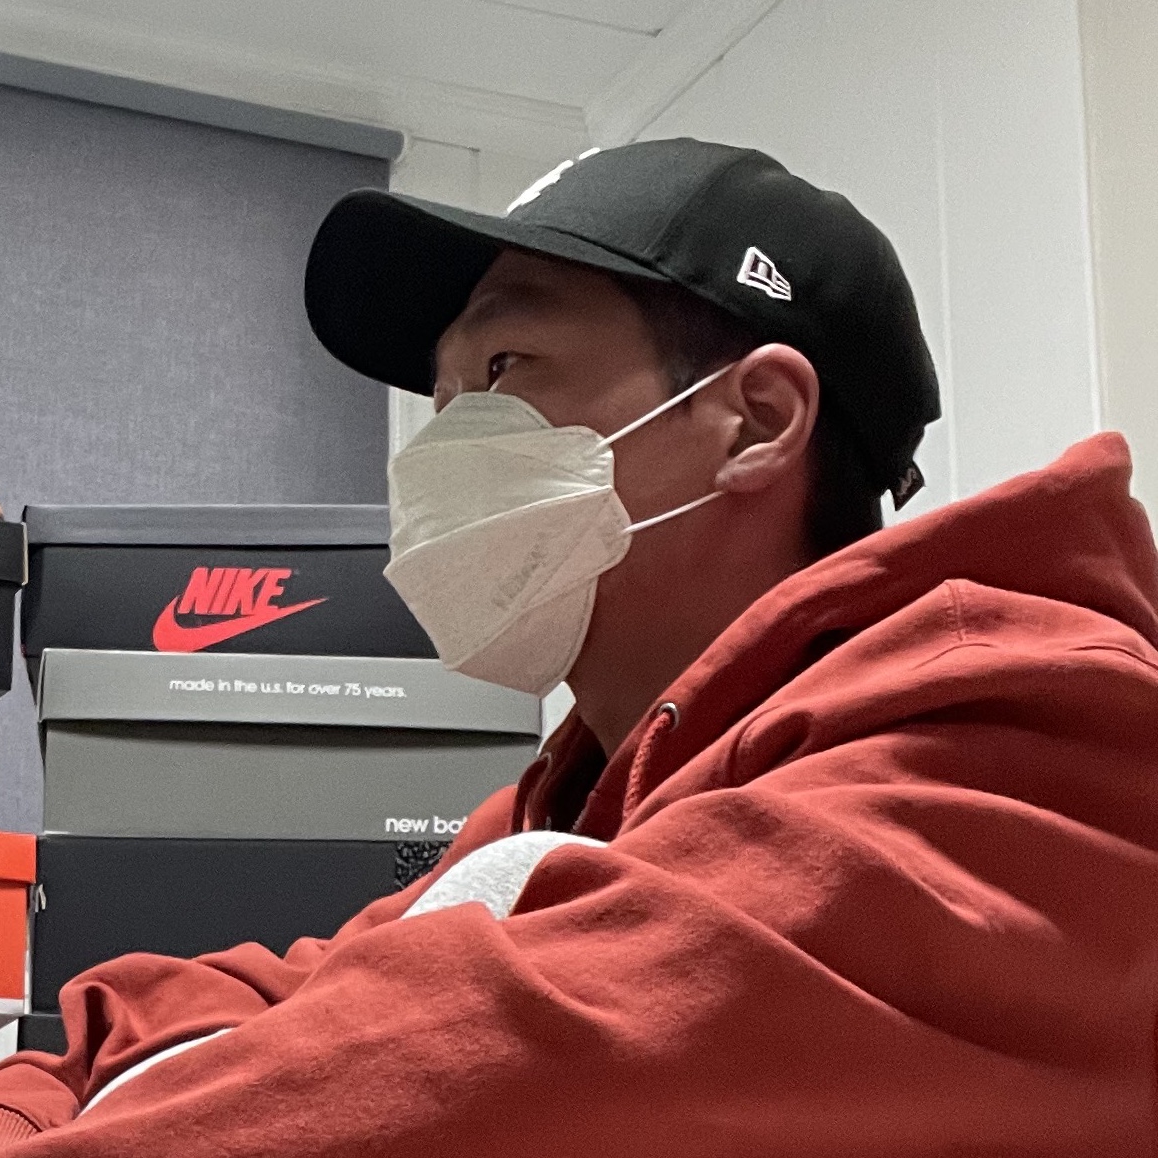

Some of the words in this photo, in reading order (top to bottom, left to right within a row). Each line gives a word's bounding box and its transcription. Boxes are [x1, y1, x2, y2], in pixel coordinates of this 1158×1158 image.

[178, 566, 293, 616] NIKE
[169, 679, 215, 692] made
[218, 679, 231, 692] in
[234, 679, 258, 694] the
[286, 681, 306, 695] for
[308, 683, 341, 696] over
[344, 682, 361, 696] 75
[364, 685, 408, 699] years.
[385, 817, 430, 833] new
